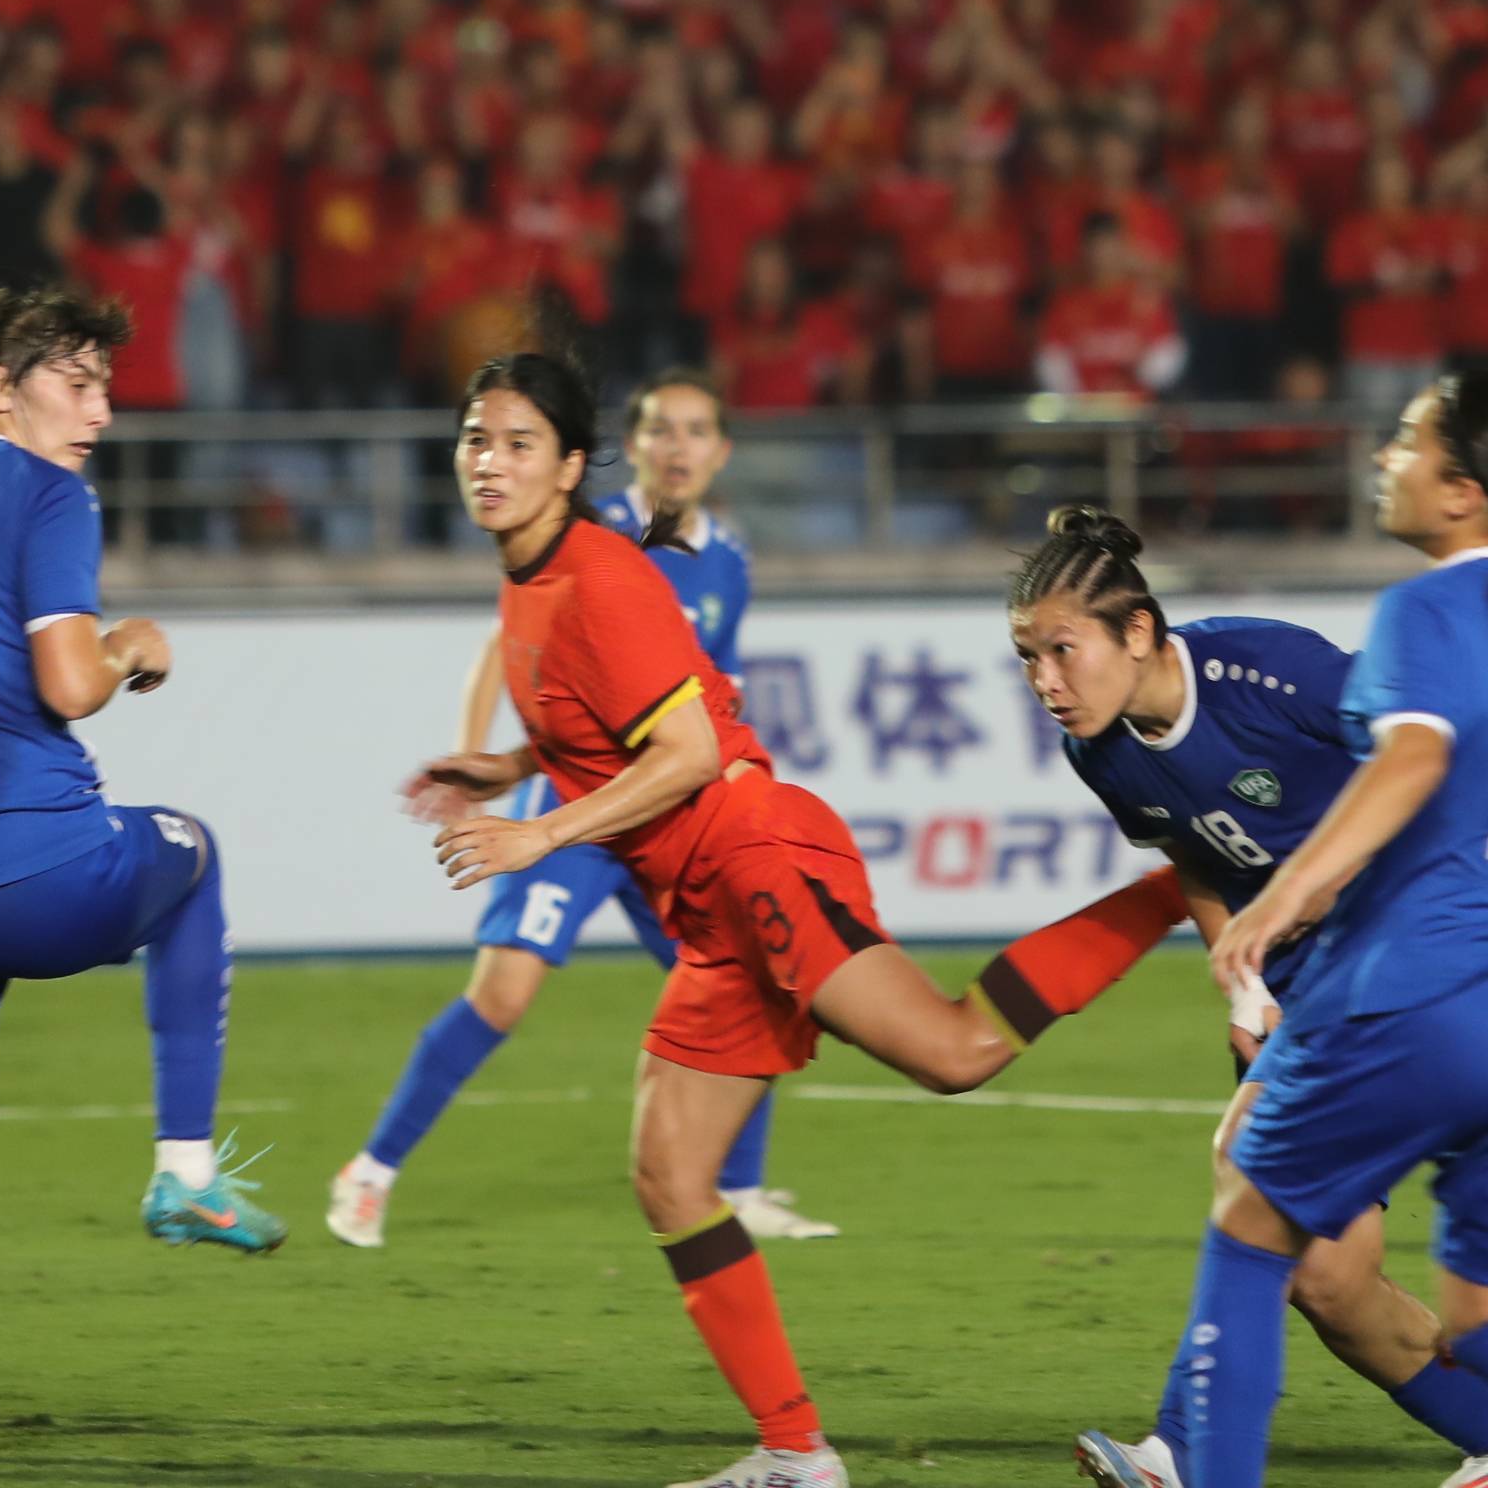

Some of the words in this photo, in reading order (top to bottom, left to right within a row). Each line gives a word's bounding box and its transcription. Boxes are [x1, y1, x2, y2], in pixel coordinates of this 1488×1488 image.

[848, 814, 1120, 892] PORT
[1190, 809, 1275, 869] 18
[516, 880, 573, 946] 16
[748, 890, 794, 955] 3
